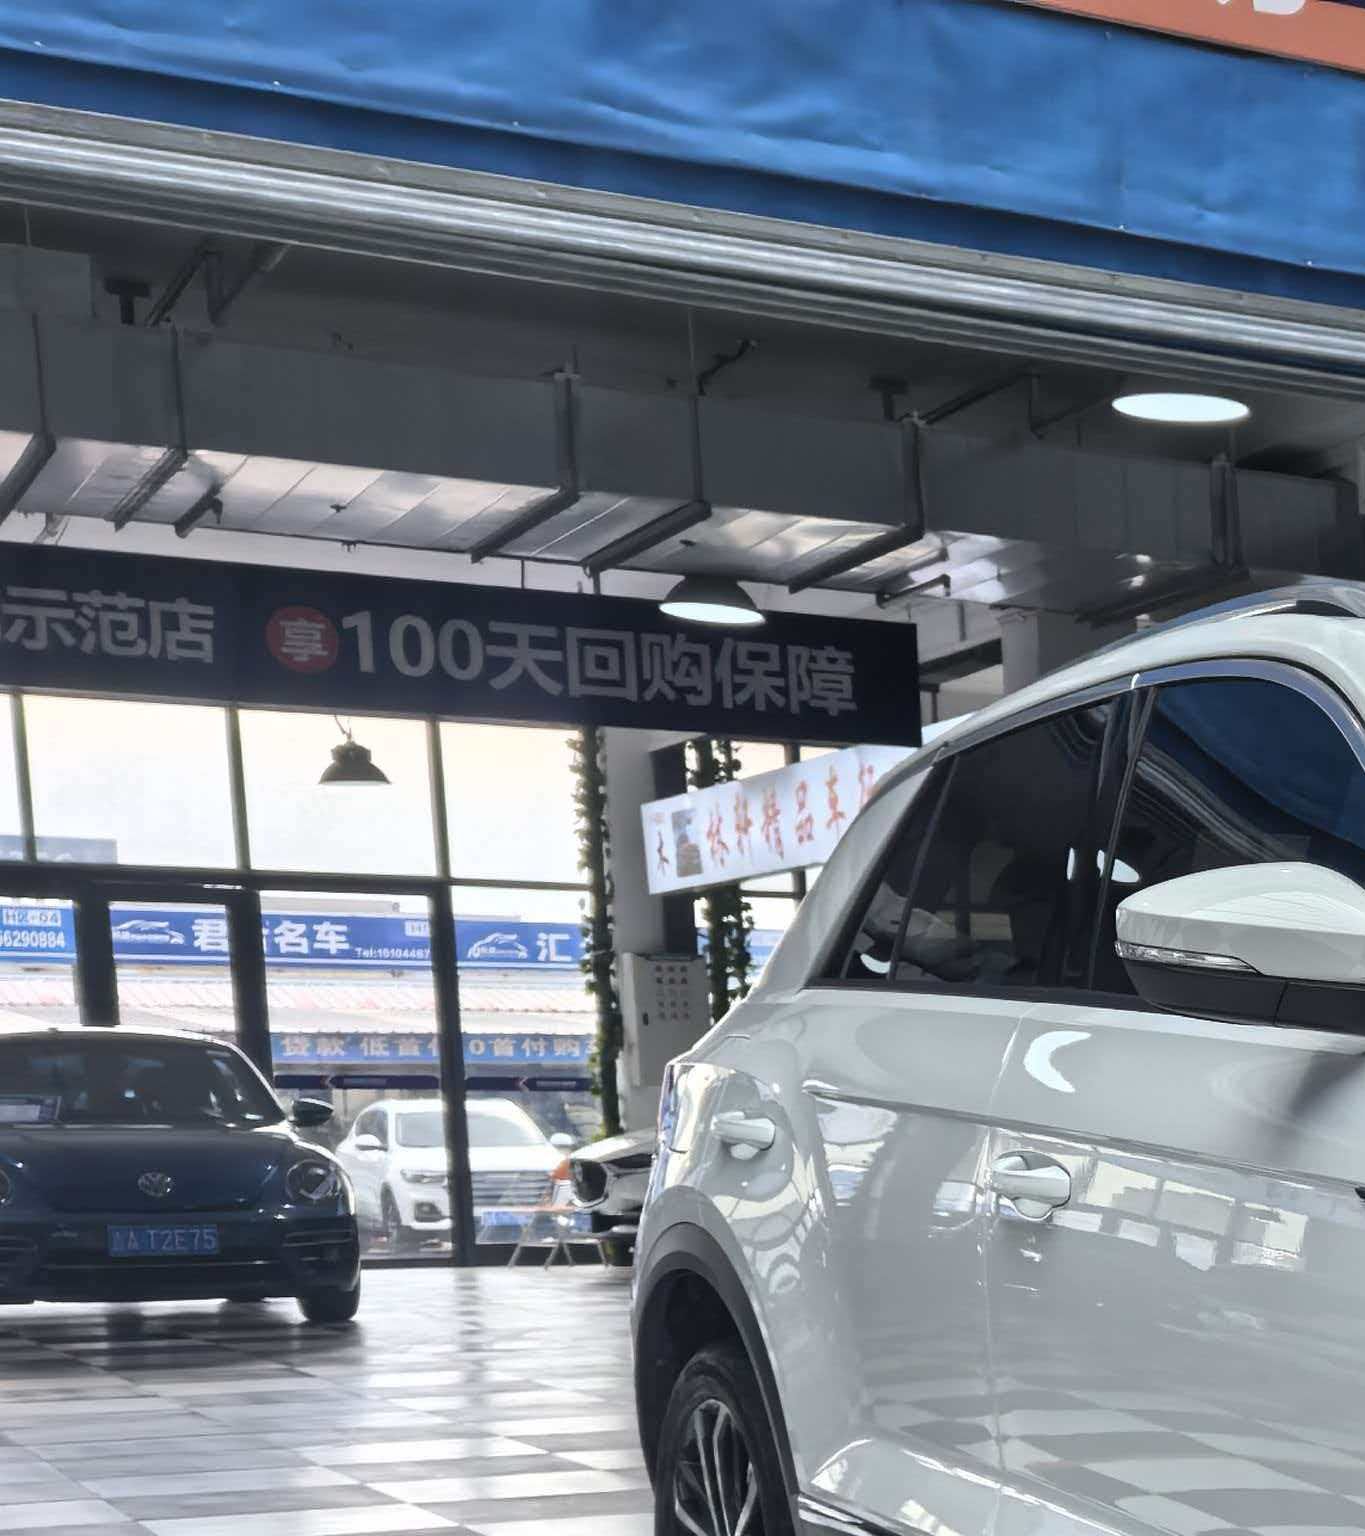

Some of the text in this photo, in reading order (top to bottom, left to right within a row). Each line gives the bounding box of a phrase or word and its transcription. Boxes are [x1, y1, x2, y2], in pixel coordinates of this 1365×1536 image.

[4, 584, 215, 665] 示范店
[192, 917, 350, 956] 君名车
